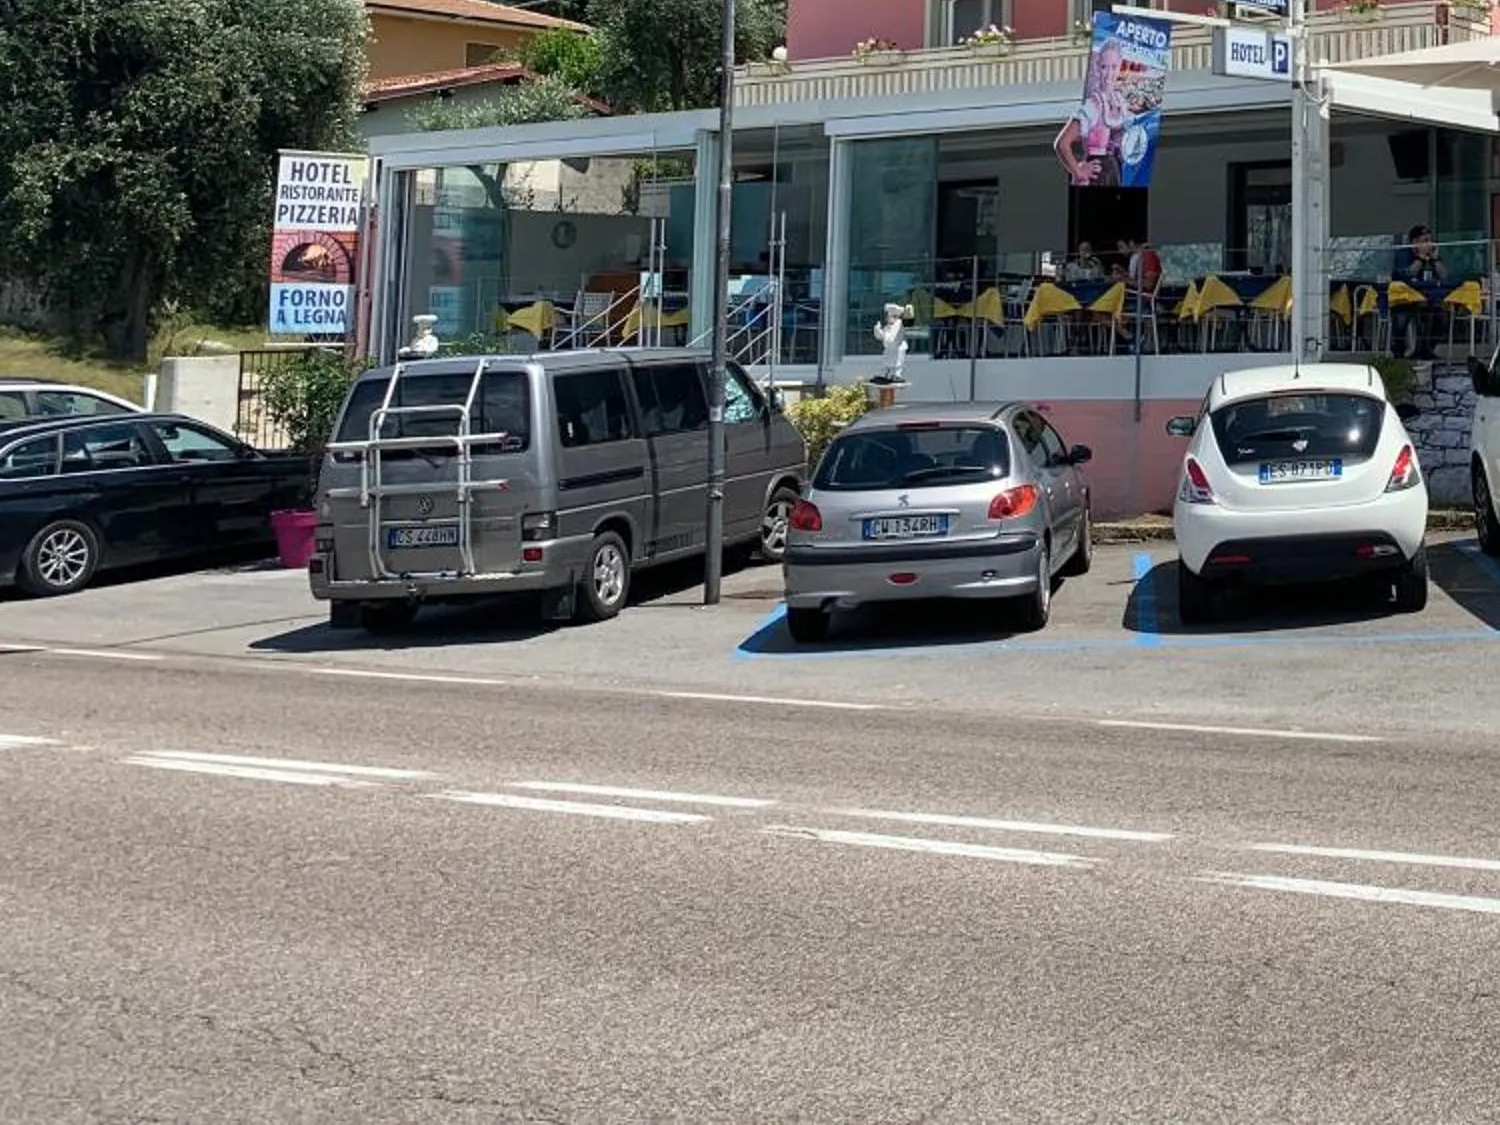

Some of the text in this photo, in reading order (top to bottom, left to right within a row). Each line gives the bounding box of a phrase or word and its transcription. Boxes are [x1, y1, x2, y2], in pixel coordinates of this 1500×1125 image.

[1115, 20, 1167, 48] APERTO
[1231, 42, 1286, 71] HOTEL P
[291, 161, 352, 184] HOTEL
[280, 184, 359, 203] RISTORANTE
[277, 204, 359, 225] PIZZERIA
[279, 289, 345, 308] FORNO
[276, 308, 347, 325] A LEGNA
